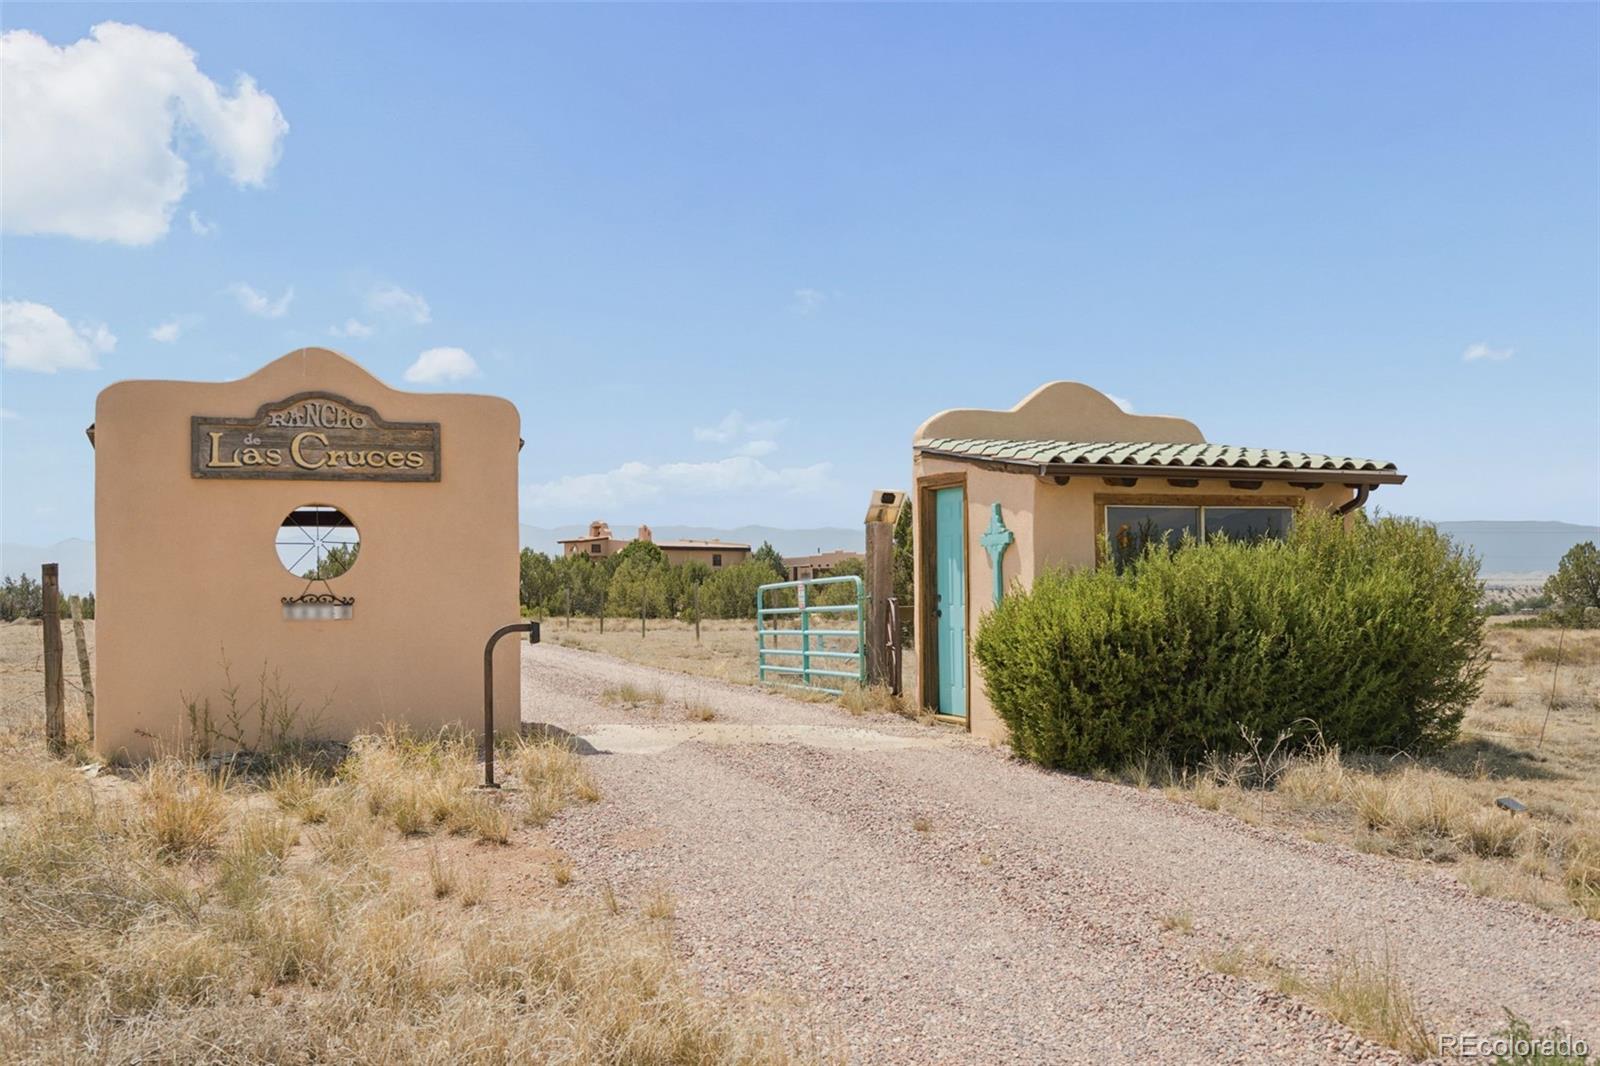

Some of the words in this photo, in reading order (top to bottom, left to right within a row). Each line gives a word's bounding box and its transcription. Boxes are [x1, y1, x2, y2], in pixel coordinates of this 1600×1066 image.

[267, 403, 367, 429] RANCHO
[207, 432, 282, 467] Las
[290, 432, 424, 470] Cruces
[243, 433, 261, 446] de
